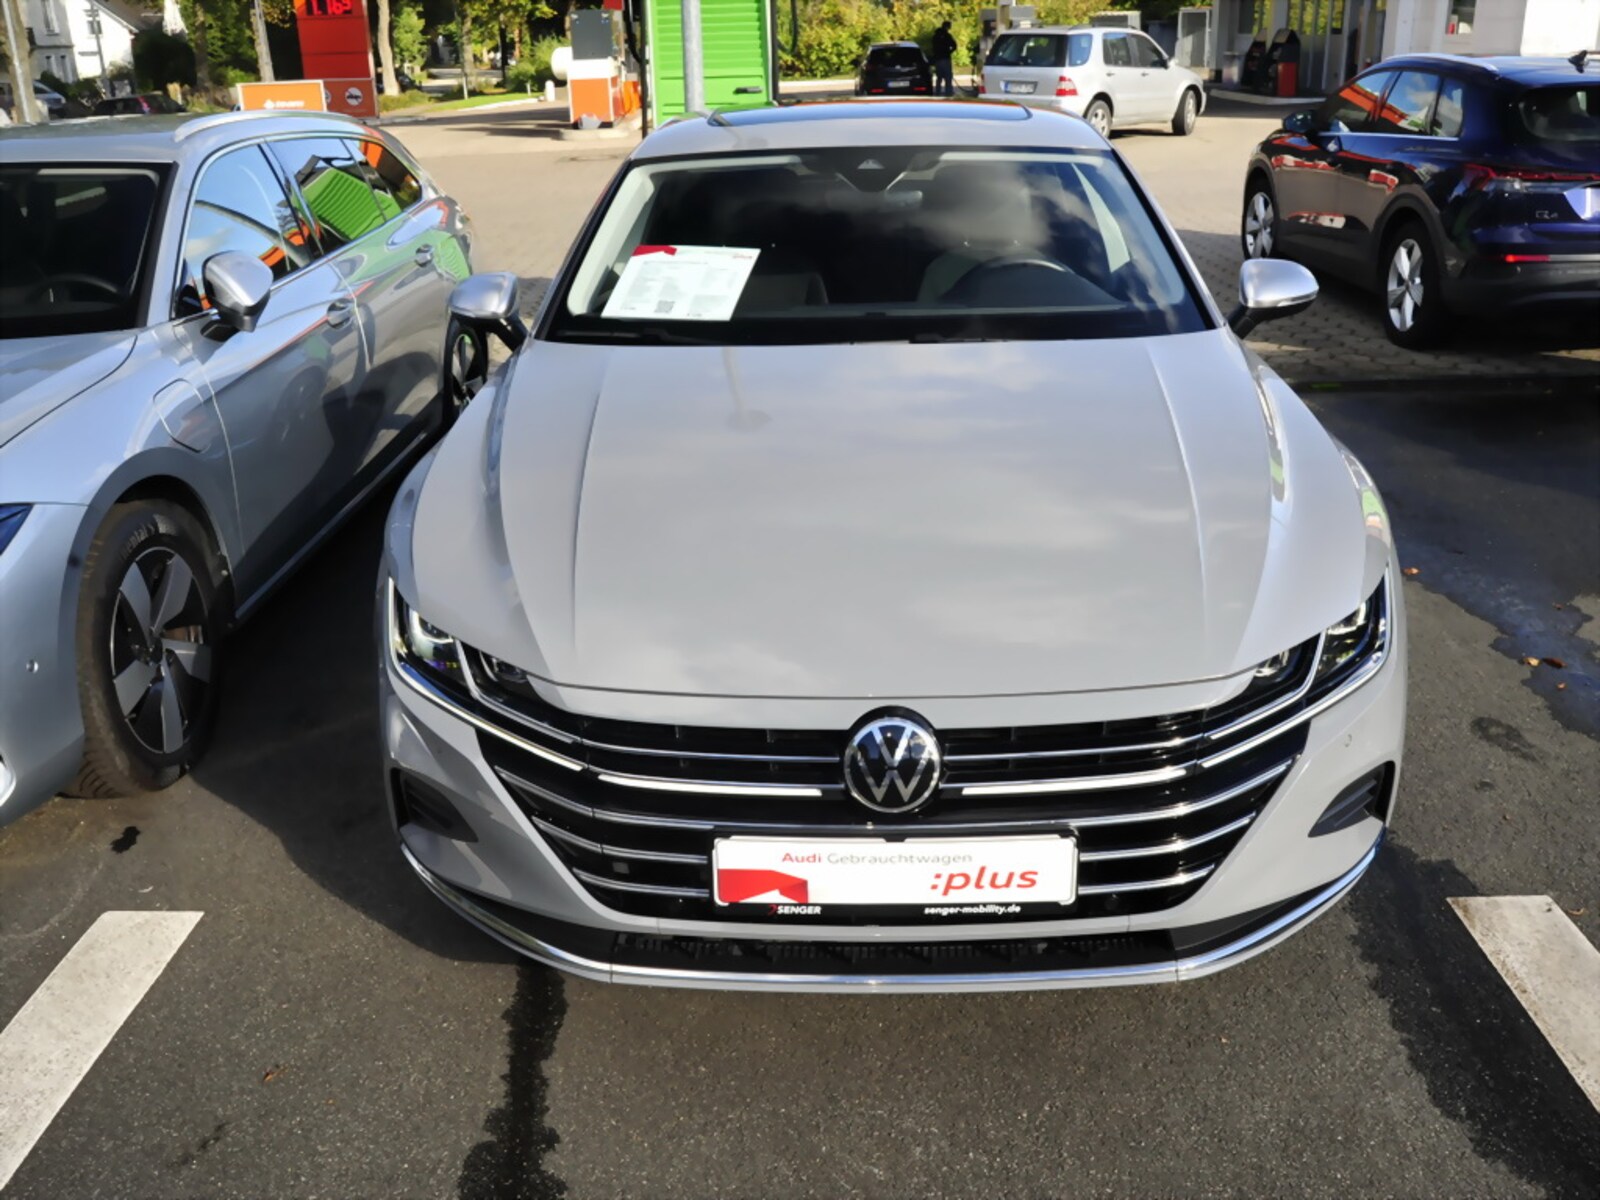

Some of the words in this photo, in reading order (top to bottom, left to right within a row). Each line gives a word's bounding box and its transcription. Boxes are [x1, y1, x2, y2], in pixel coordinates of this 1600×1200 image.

[781, 852, 822, 864] Audi
[826, 852, 973, 866] Gebrauchtwagen
[930, 866, 1039, 896] :plus
[776, 905, 822, 916] SENGER
[923, 903, 1022, 917] senger-mobility.de
